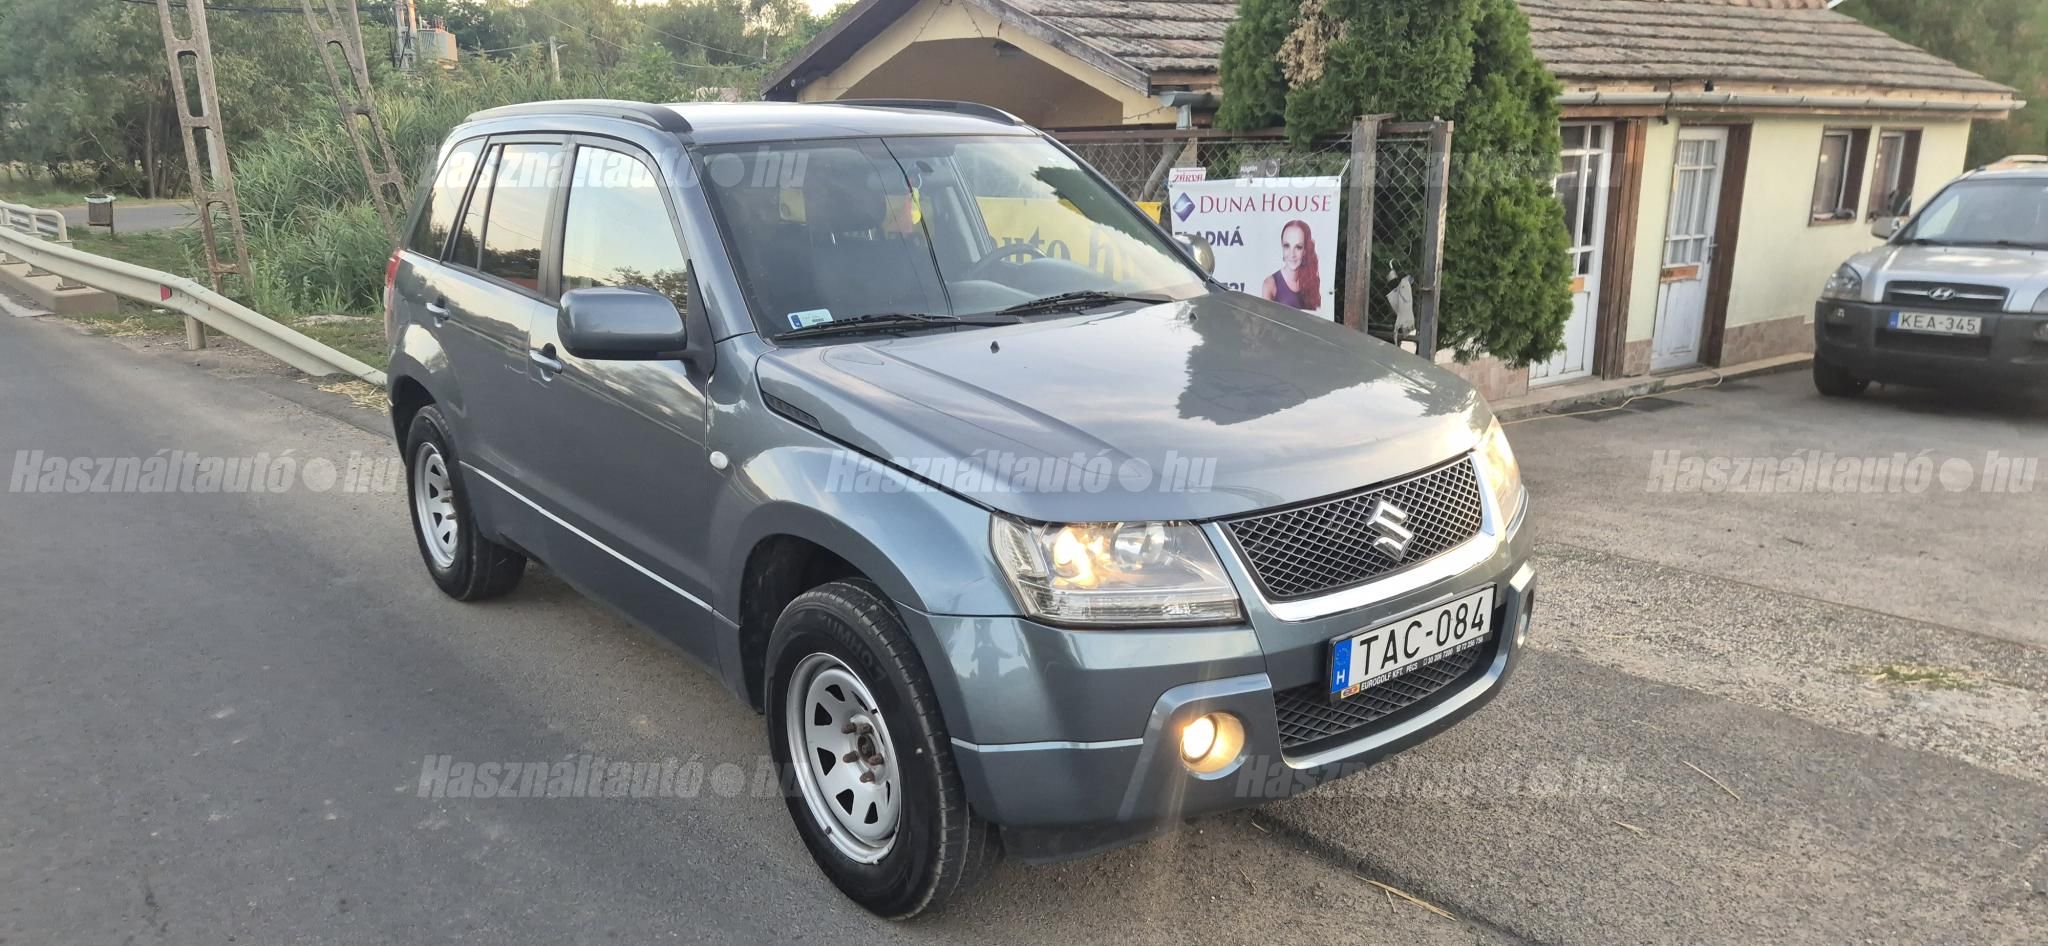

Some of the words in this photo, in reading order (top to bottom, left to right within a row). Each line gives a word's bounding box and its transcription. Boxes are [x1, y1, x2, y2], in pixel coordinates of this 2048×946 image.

[1200, 194, 1256, 214] DUNA
[1261, 193, 1332, 213] HOUSE
[1901, 314, 1976, 332] KEA-345
[1360, 597, 1484, 676] TAC-084
[1336, 669, 1346, 686] H
[1360, 671, 1392, 691] EUROGOLF
